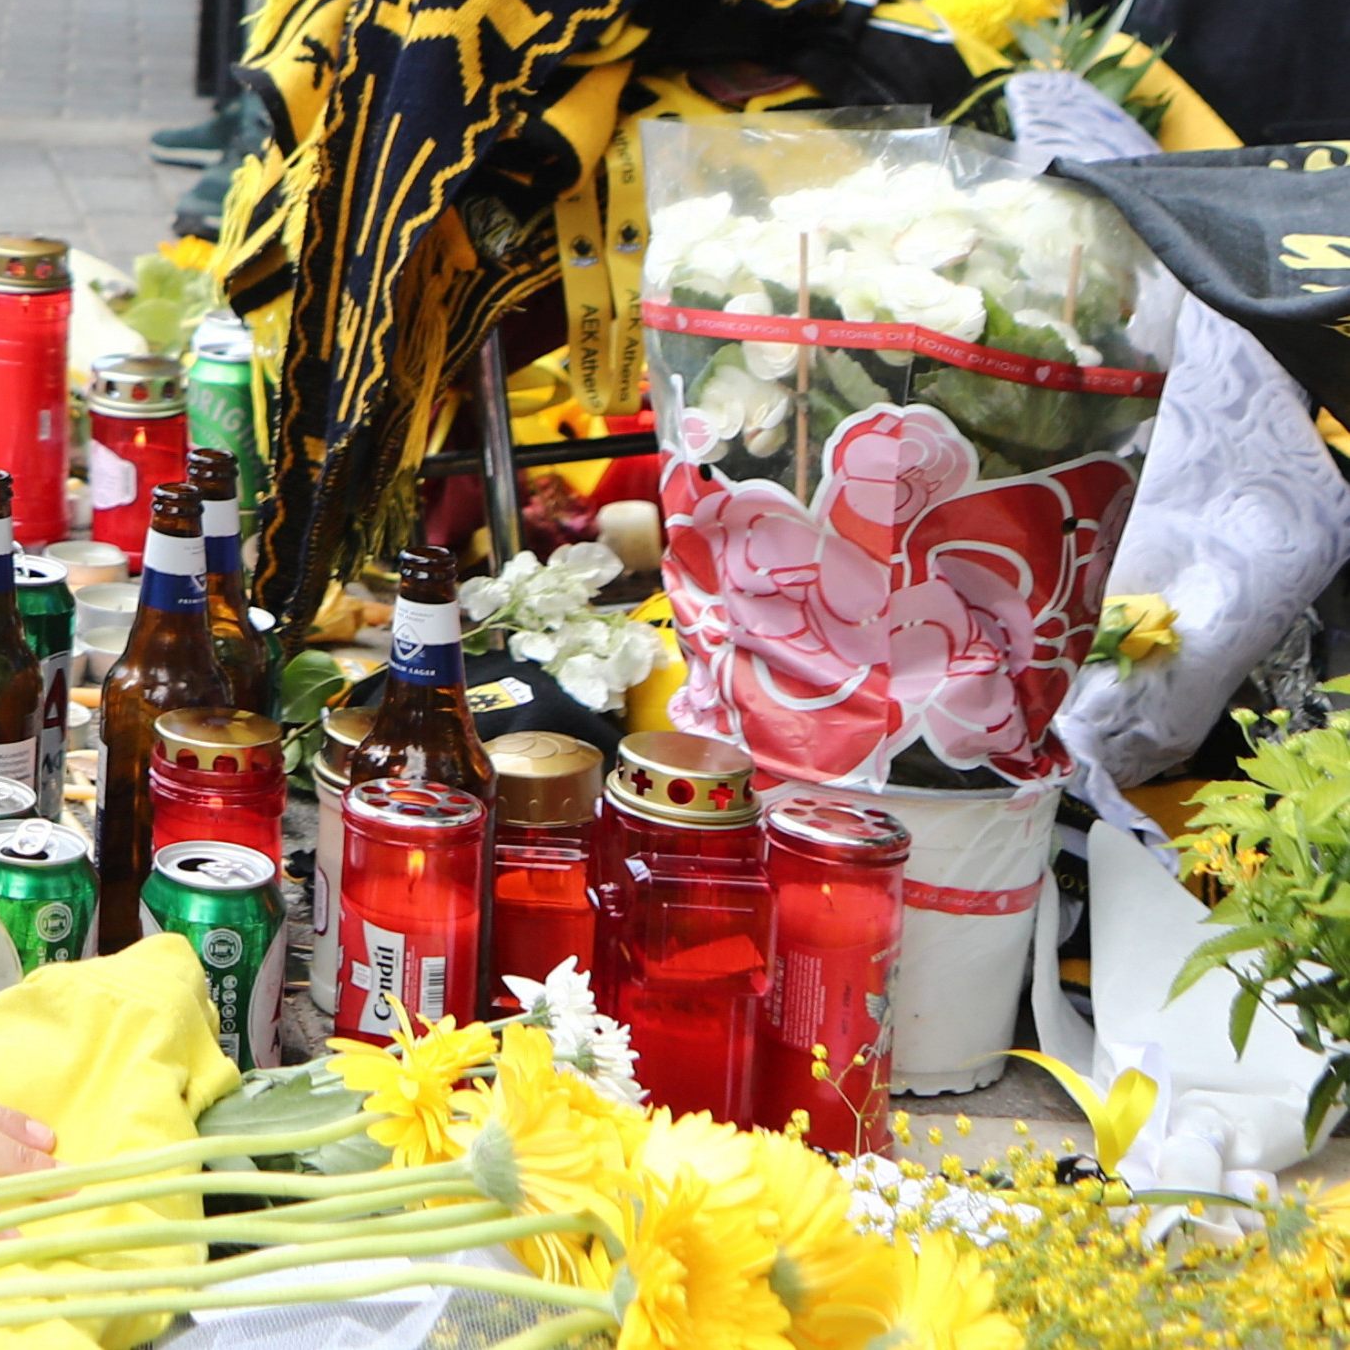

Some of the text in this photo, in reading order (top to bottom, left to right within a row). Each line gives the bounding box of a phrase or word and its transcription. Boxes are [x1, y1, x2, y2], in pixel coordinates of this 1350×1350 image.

[580, 303, 602, 409] AEK Athens
[914, 333, 966, 360] TORIE
